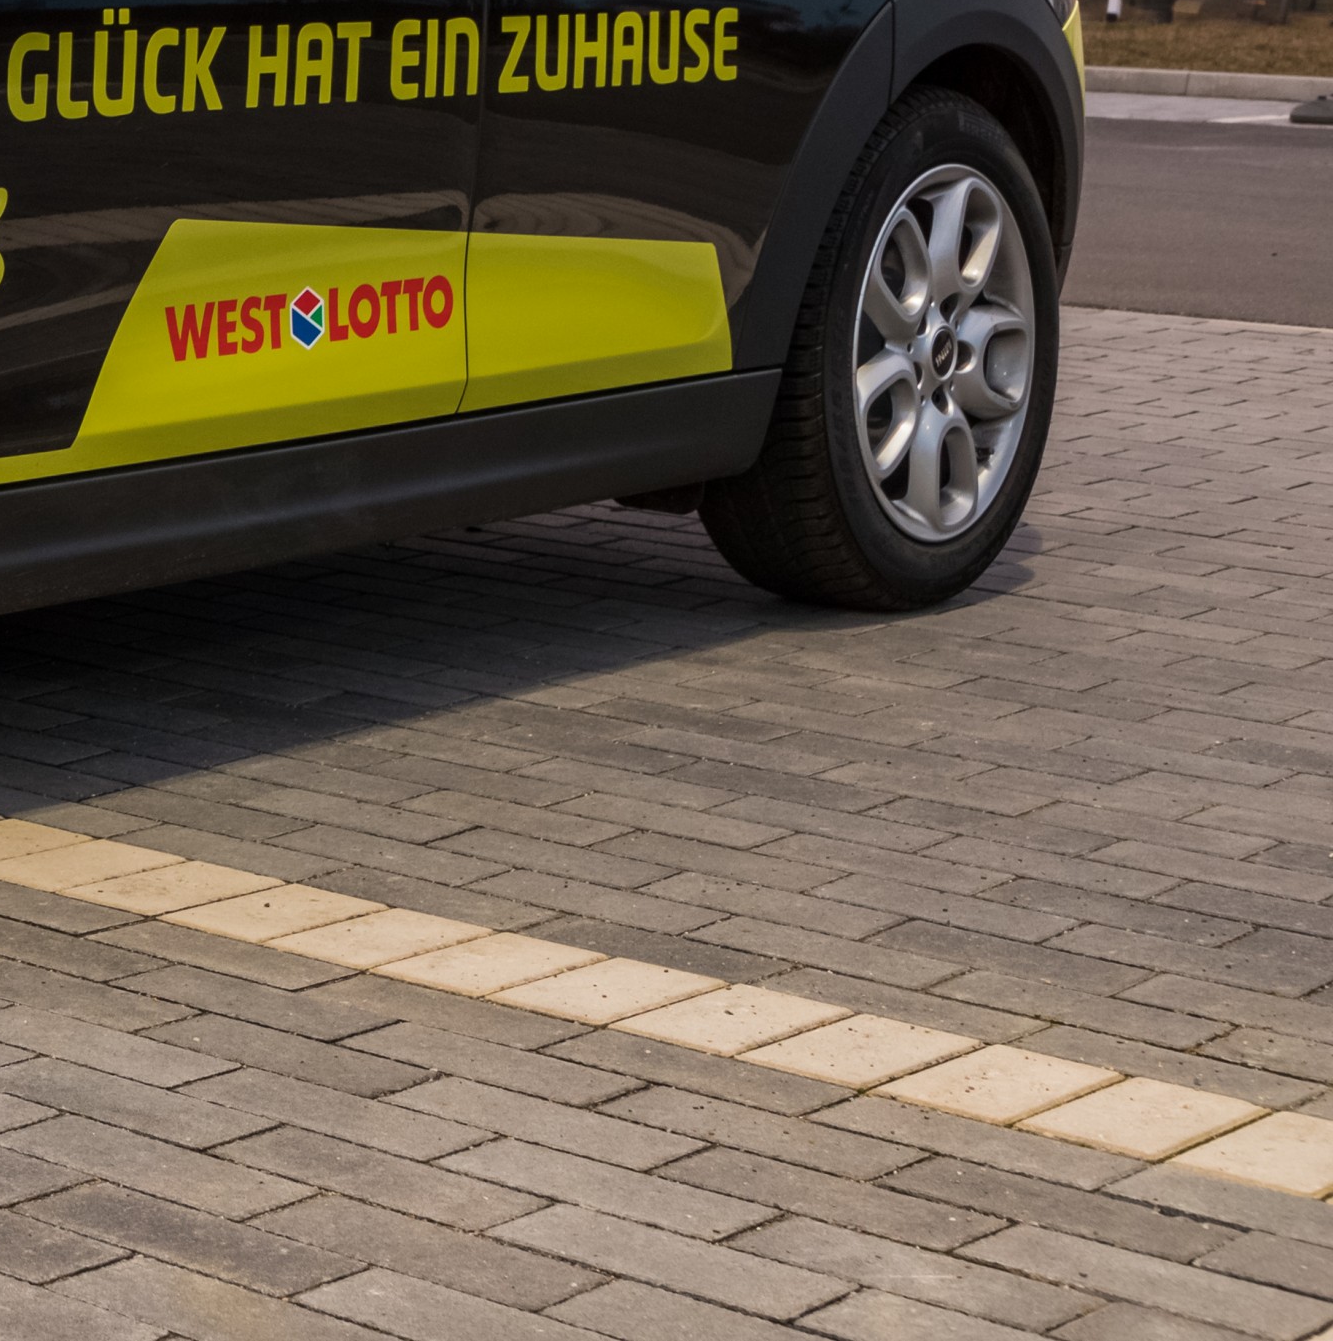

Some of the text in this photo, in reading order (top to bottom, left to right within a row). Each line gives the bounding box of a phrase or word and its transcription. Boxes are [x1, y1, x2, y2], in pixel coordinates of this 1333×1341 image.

[7, 7, 739, 122] GLÜCK HAT EIN ZUHAUSE
[165, 275, 454, 362] WEST LOTTO
